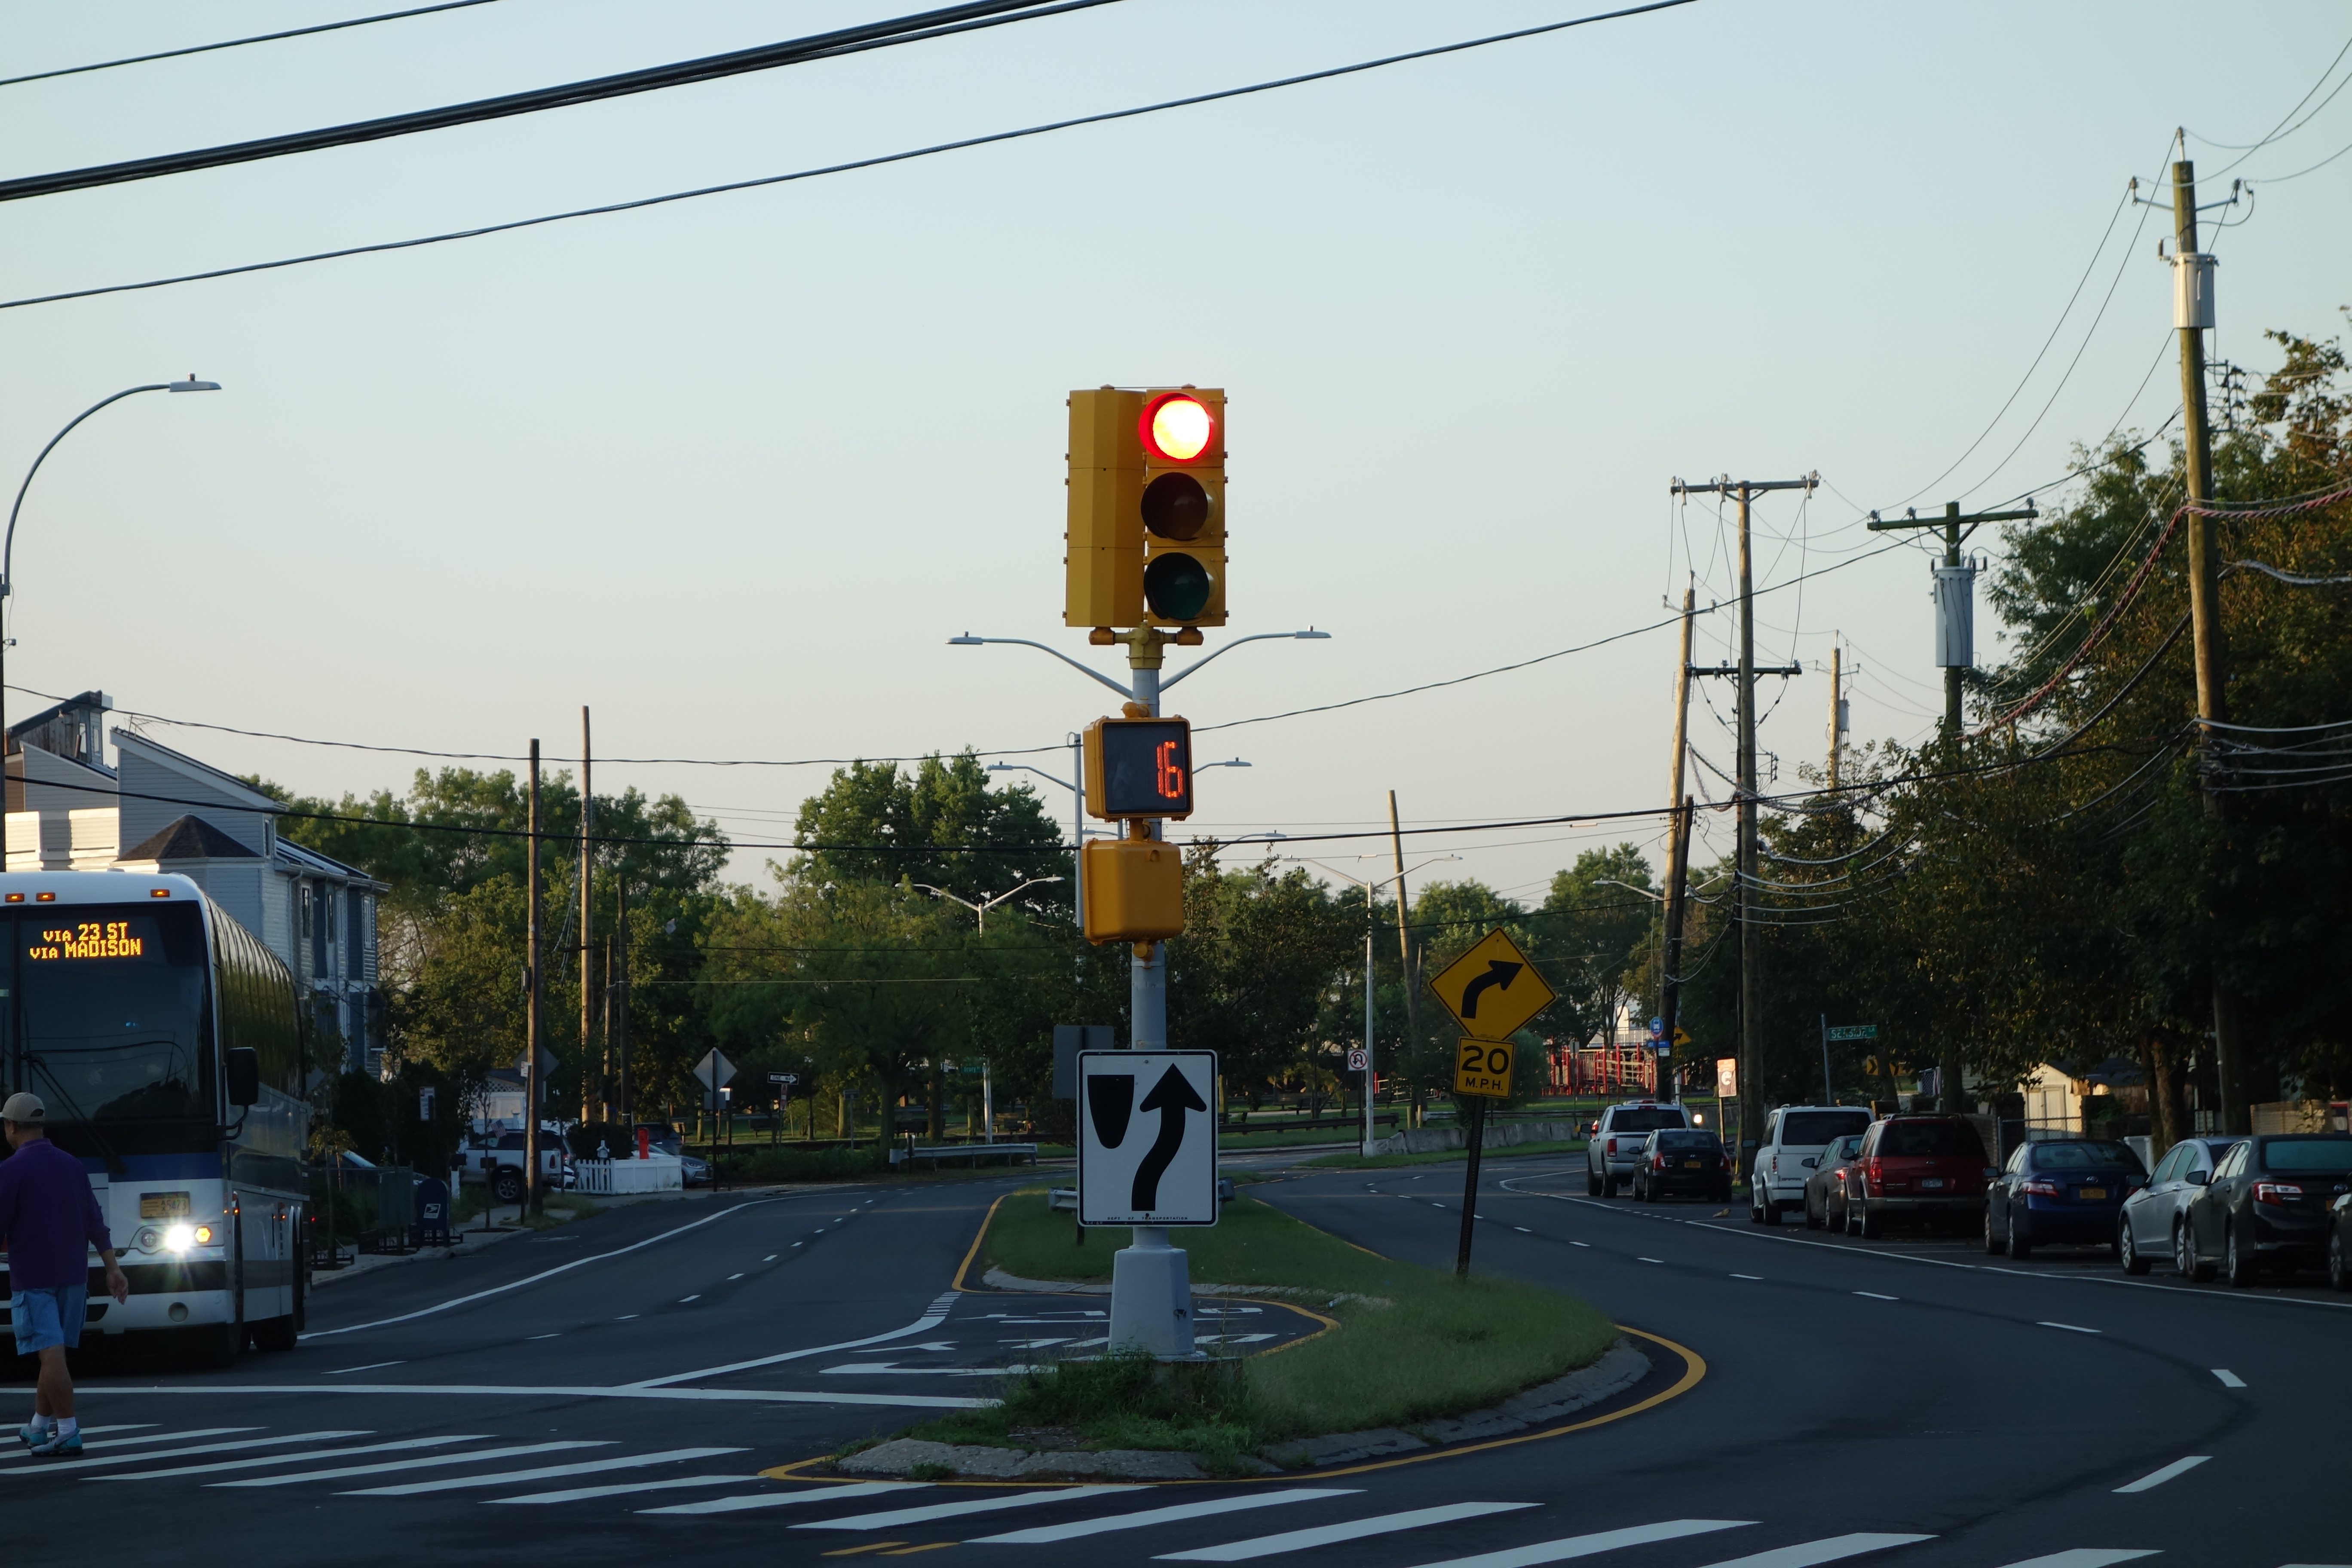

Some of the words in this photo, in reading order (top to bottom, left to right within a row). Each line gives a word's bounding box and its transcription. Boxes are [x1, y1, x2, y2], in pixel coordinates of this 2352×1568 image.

[43, 930, 72, 942] VIA
[78, 923, 100, 941] 23
[107, 922, 128, 940] ST
[29, 946, 58, 959] VIA
[64, 938, 141, 958] MADISON
[1461, 1045, 1509, 1075] 20
[1465, 1076, 1503, 1091] M.P.H.
